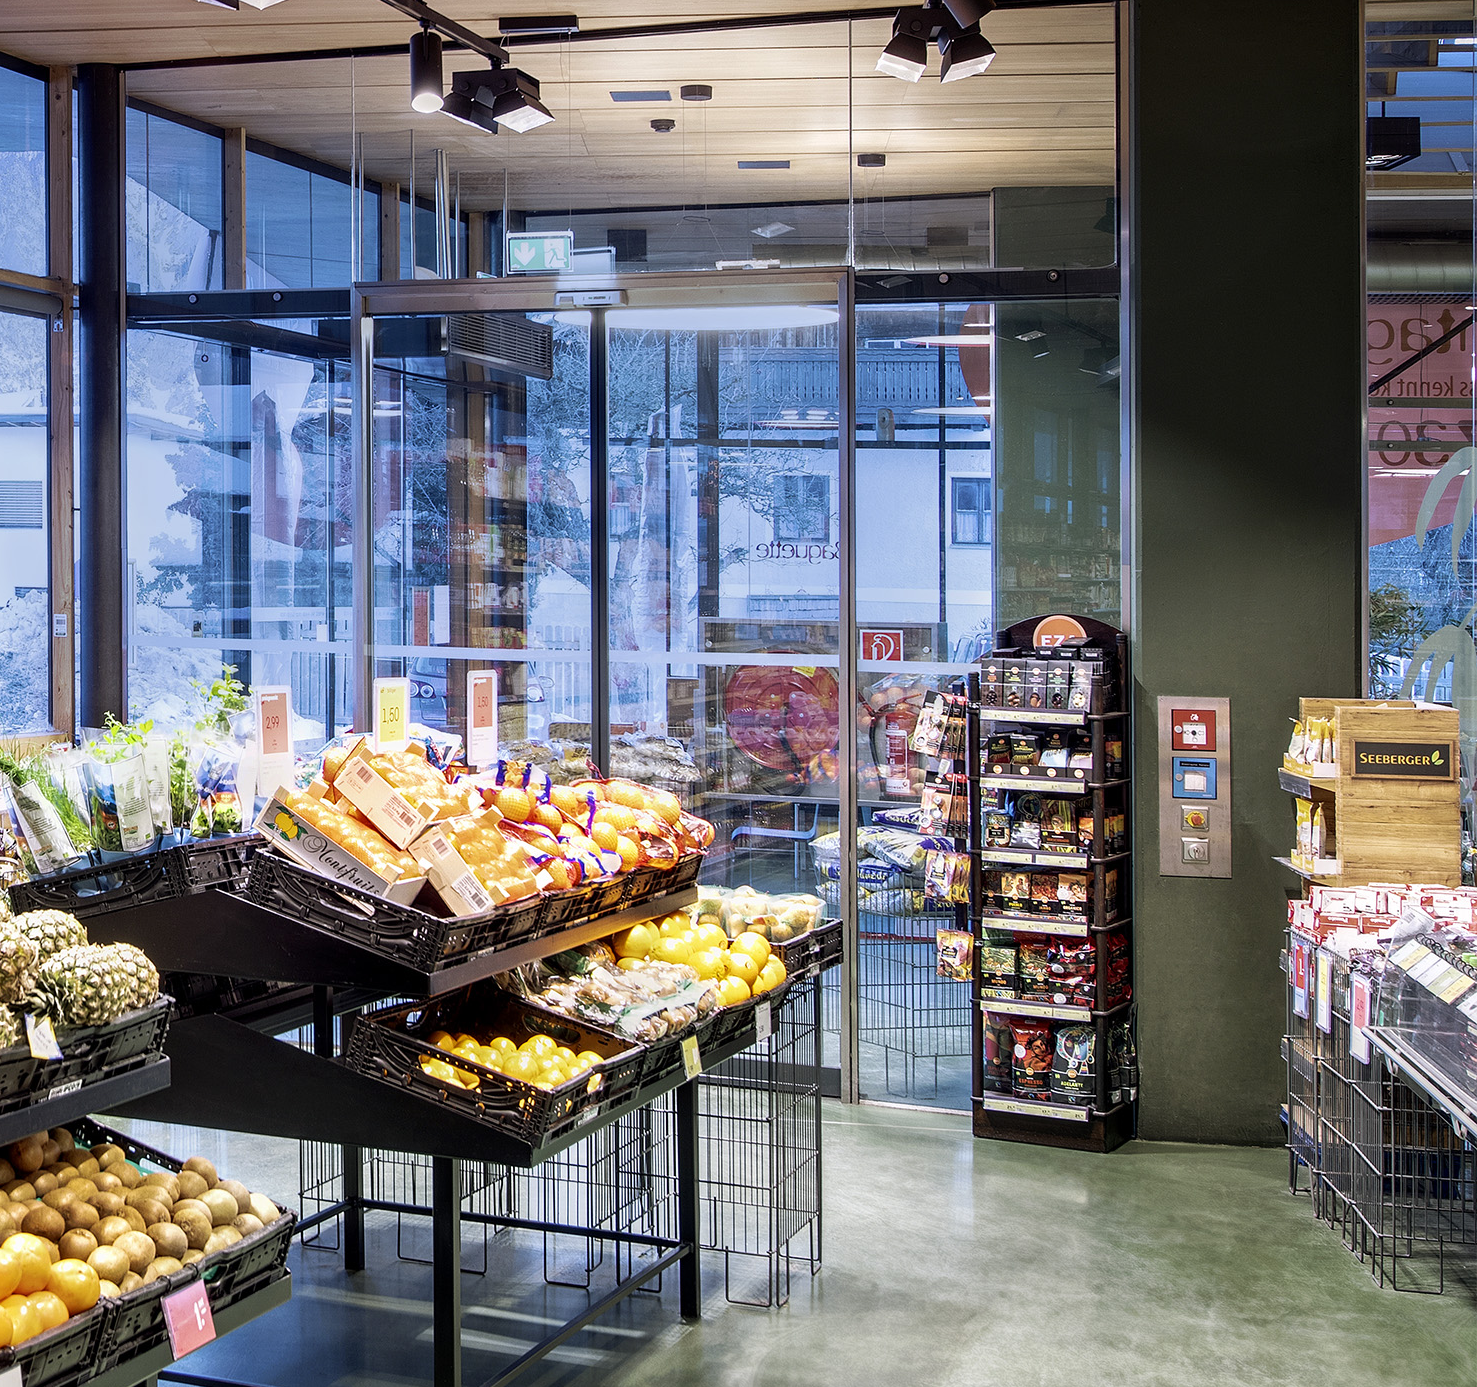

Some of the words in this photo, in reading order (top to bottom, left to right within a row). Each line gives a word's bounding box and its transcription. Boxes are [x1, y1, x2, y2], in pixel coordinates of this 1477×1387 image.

[1041, 634, 1076, 647] EZ
[477, 696, 488, 708] 1,50
[382, 706, 400, 724] 1,50
[266, 715, 280, 730] 2,99
[1359, 752, 1431, 766] SEEBERGER
